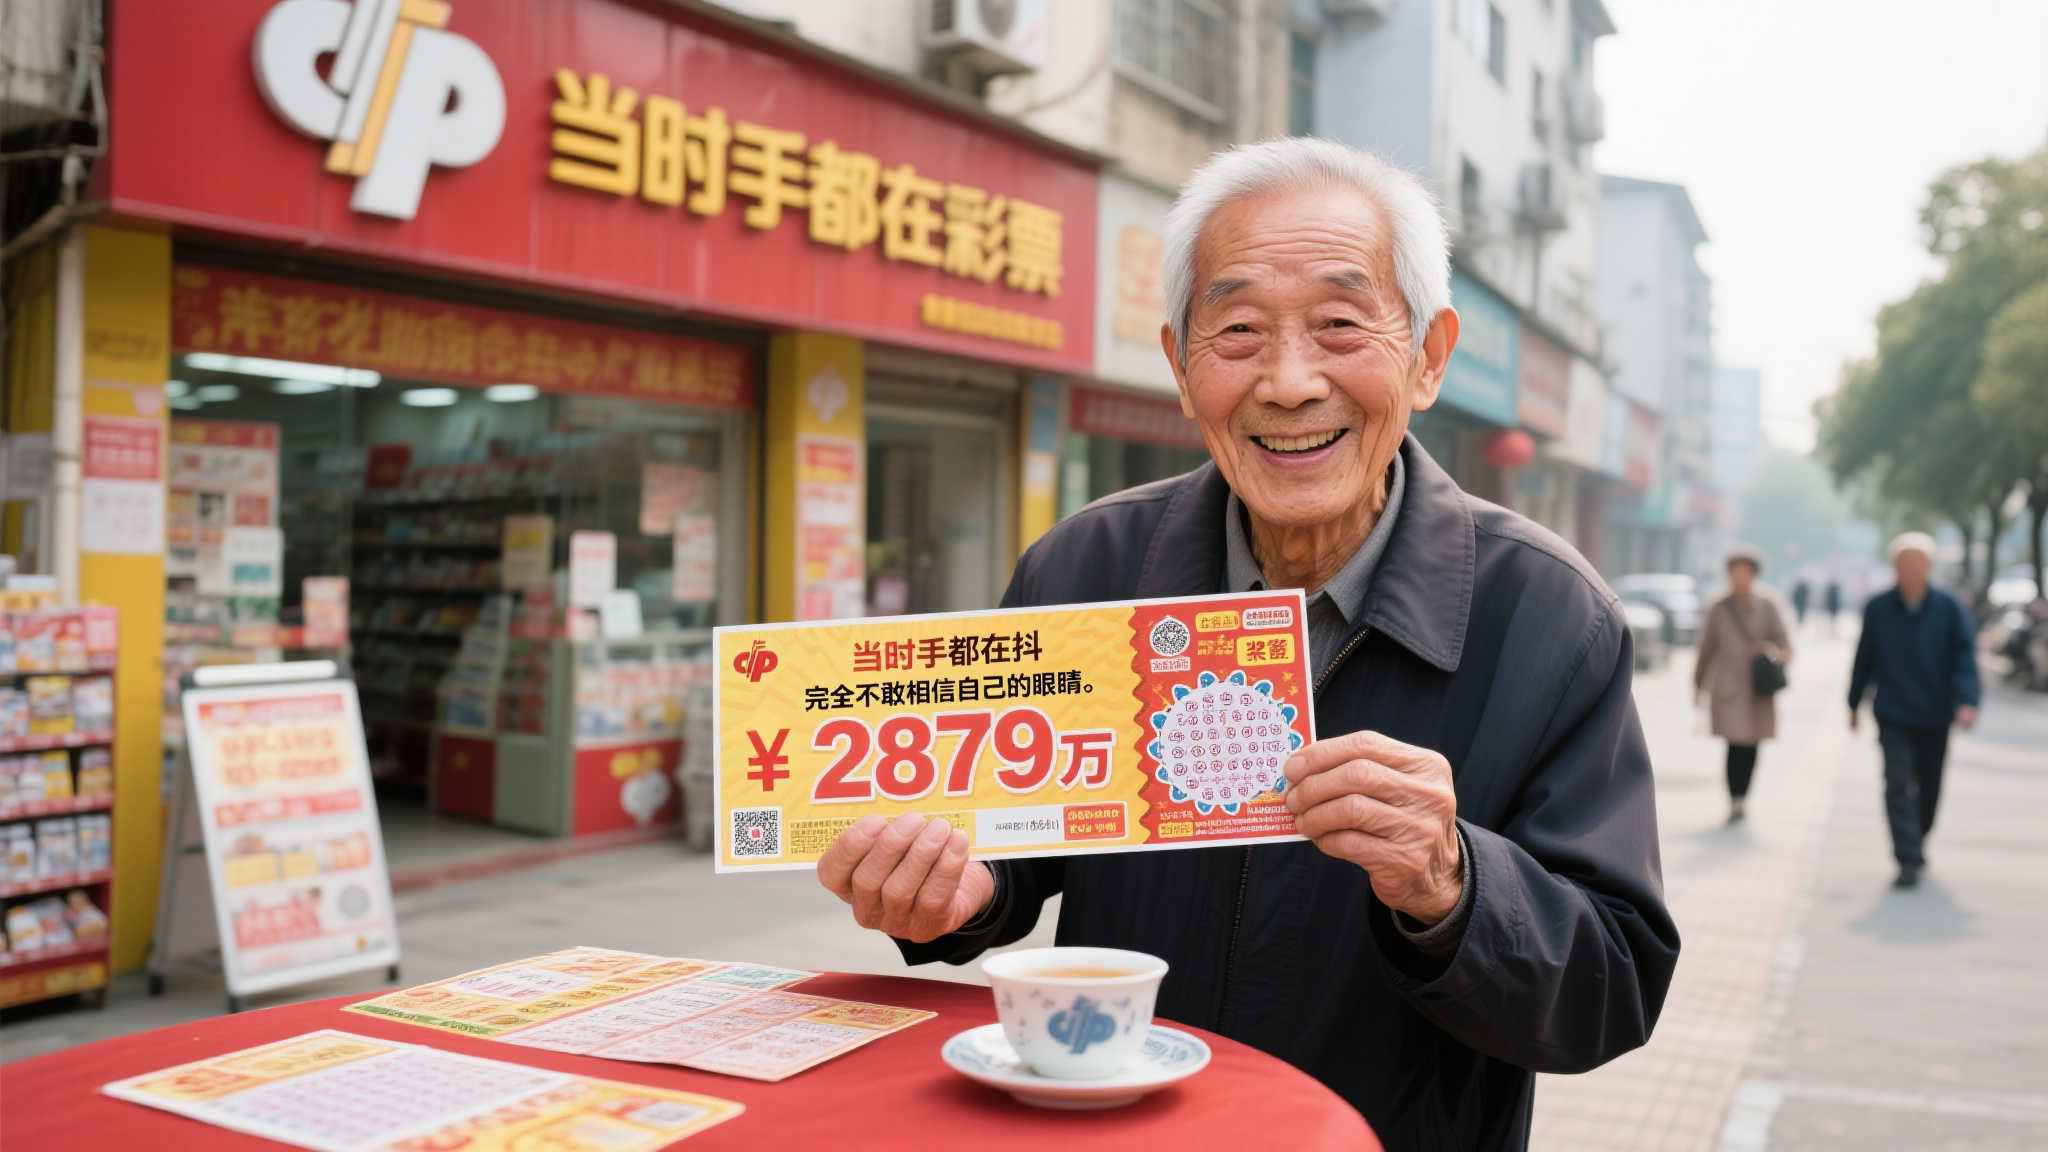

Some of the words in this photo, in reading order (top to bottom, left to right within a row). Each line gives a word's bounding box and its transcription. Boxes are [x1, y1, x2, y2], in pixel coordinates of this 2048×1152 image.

[549, 68, 1064, 298] 当时手都在彩票
[853, 630, 1042, 672] 当时手都在抖
[805, 670, 1093, 711] 完全不敢相信自己的眼睛。
